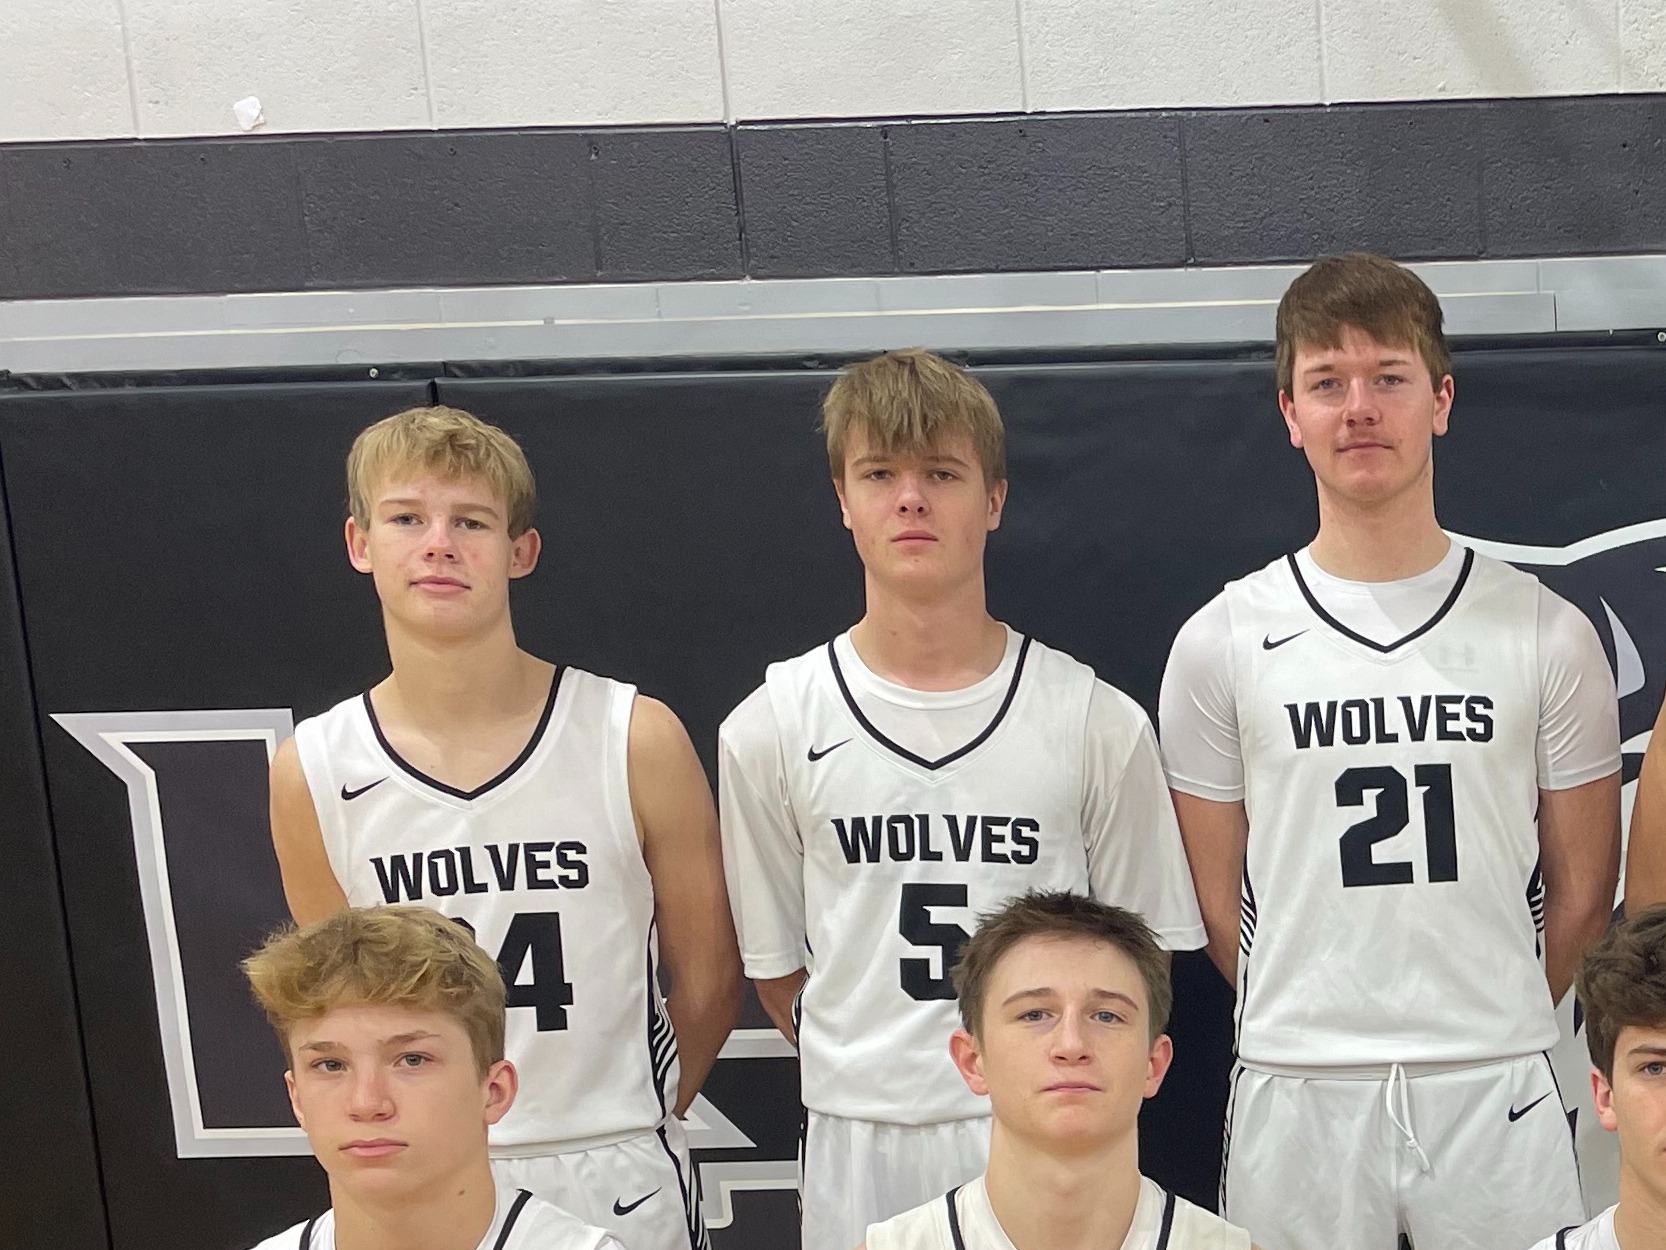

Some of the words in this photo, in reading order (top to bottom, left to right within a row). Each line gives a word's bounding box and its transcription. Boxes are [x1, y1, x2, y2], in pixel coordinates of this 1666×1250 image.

[1284, 695, 1493, 749] WOLVES
[831, 814, 1039, 864] WOLVES
[1335, 764, 1458, 887] 21
[369, 841, 589, 904] WOLVES
[452, 911, 573, 1033] 4
[899, 883, 973, 1001] 5
